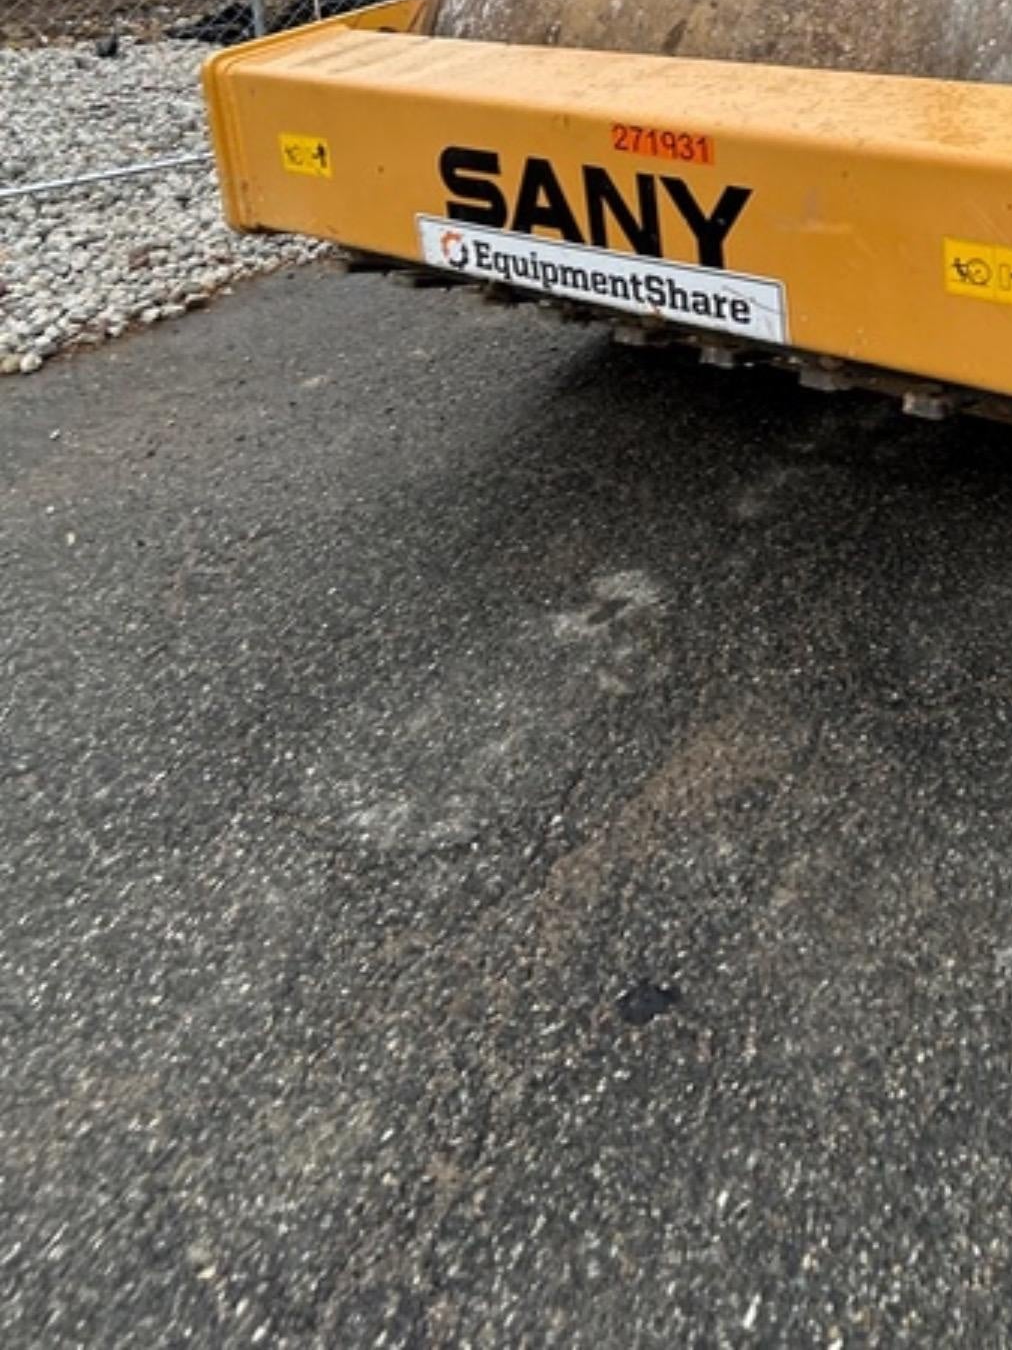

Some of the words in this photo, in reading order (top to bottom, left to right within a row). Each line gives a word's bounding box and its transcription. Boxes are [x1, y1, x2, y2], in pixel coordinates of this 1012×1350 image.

[612, 123, 709, 163] 271931
[439, 146, 753, 269] SANY
[473, 239, 751, 324] EquipmentShare
